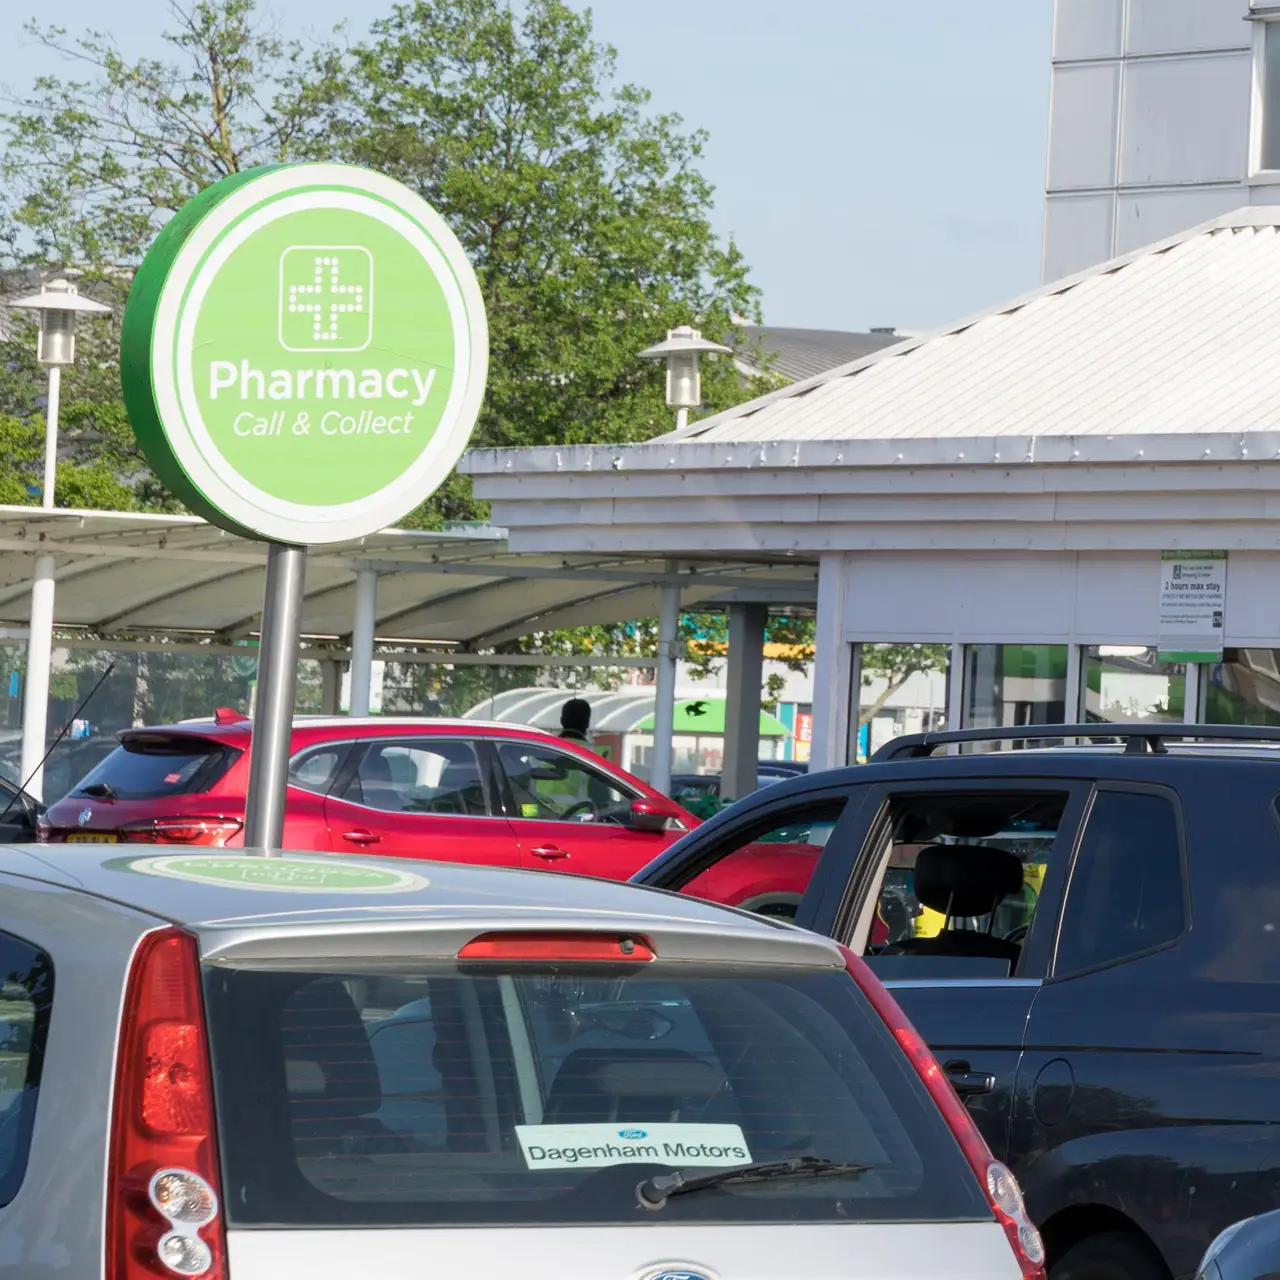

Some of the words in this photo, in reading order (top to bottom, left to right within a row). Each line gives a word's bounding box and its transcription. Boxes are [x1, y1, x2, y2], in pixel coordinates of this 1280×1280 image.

[209, 359, 437, 407] Pharmacy
[233, 410, 286, 437] Call
[292, 411, 311, 435] &
[320, 410, 414, 436] Collect
[1165, 581, 1169, 591] 2
[1170, 581, 1189, 591] hours
[1190, 583, 1204, 591] max
[1206, 581, 1221, 592] stay
[619, 1130, 647, 1139] Ford
[528, 1143, 658, 1162] Dagenham
[663, 1143, 746, 1158] Motors
